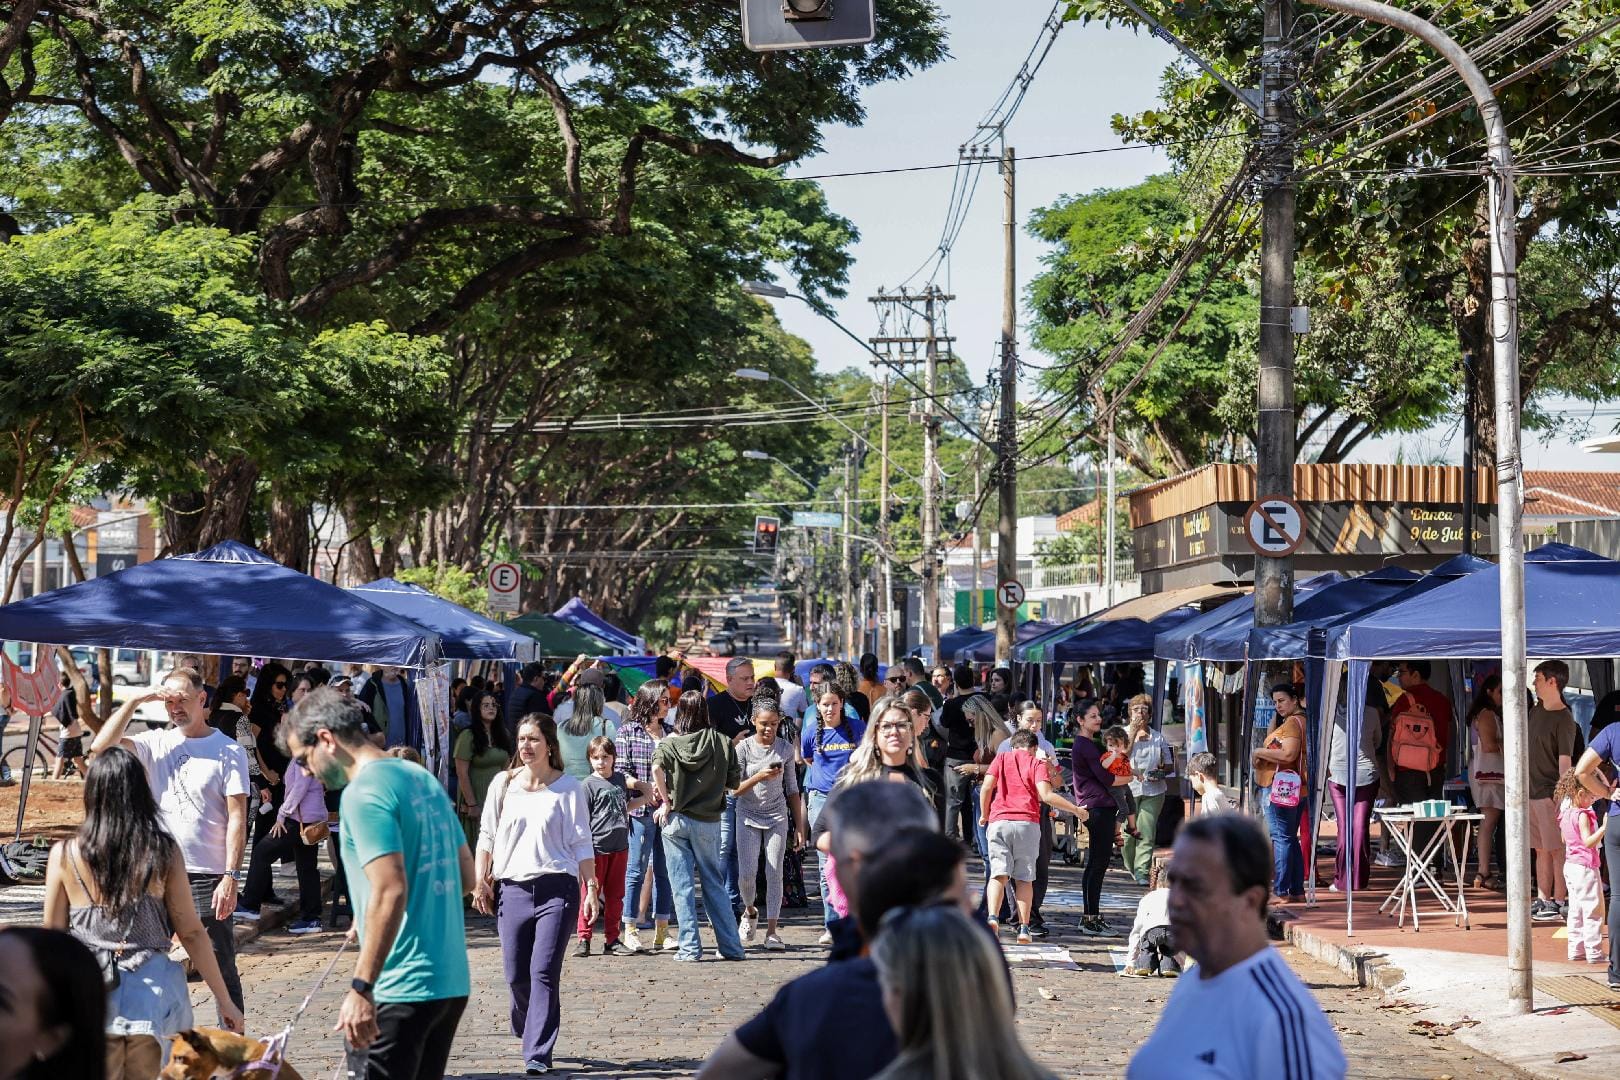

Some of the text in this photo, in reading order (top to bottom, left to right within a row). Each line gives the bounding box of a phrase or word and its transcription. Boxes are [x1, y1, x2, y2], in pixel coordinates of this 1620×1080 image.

[1411, 507, 1454, 521] Banca
[1263, 506, 1287, 544] E
[1410, 526, 1482, 543] 9 de Julo
[499, 569, 509, 586] E
[1005, 585, 1016, 603] E
